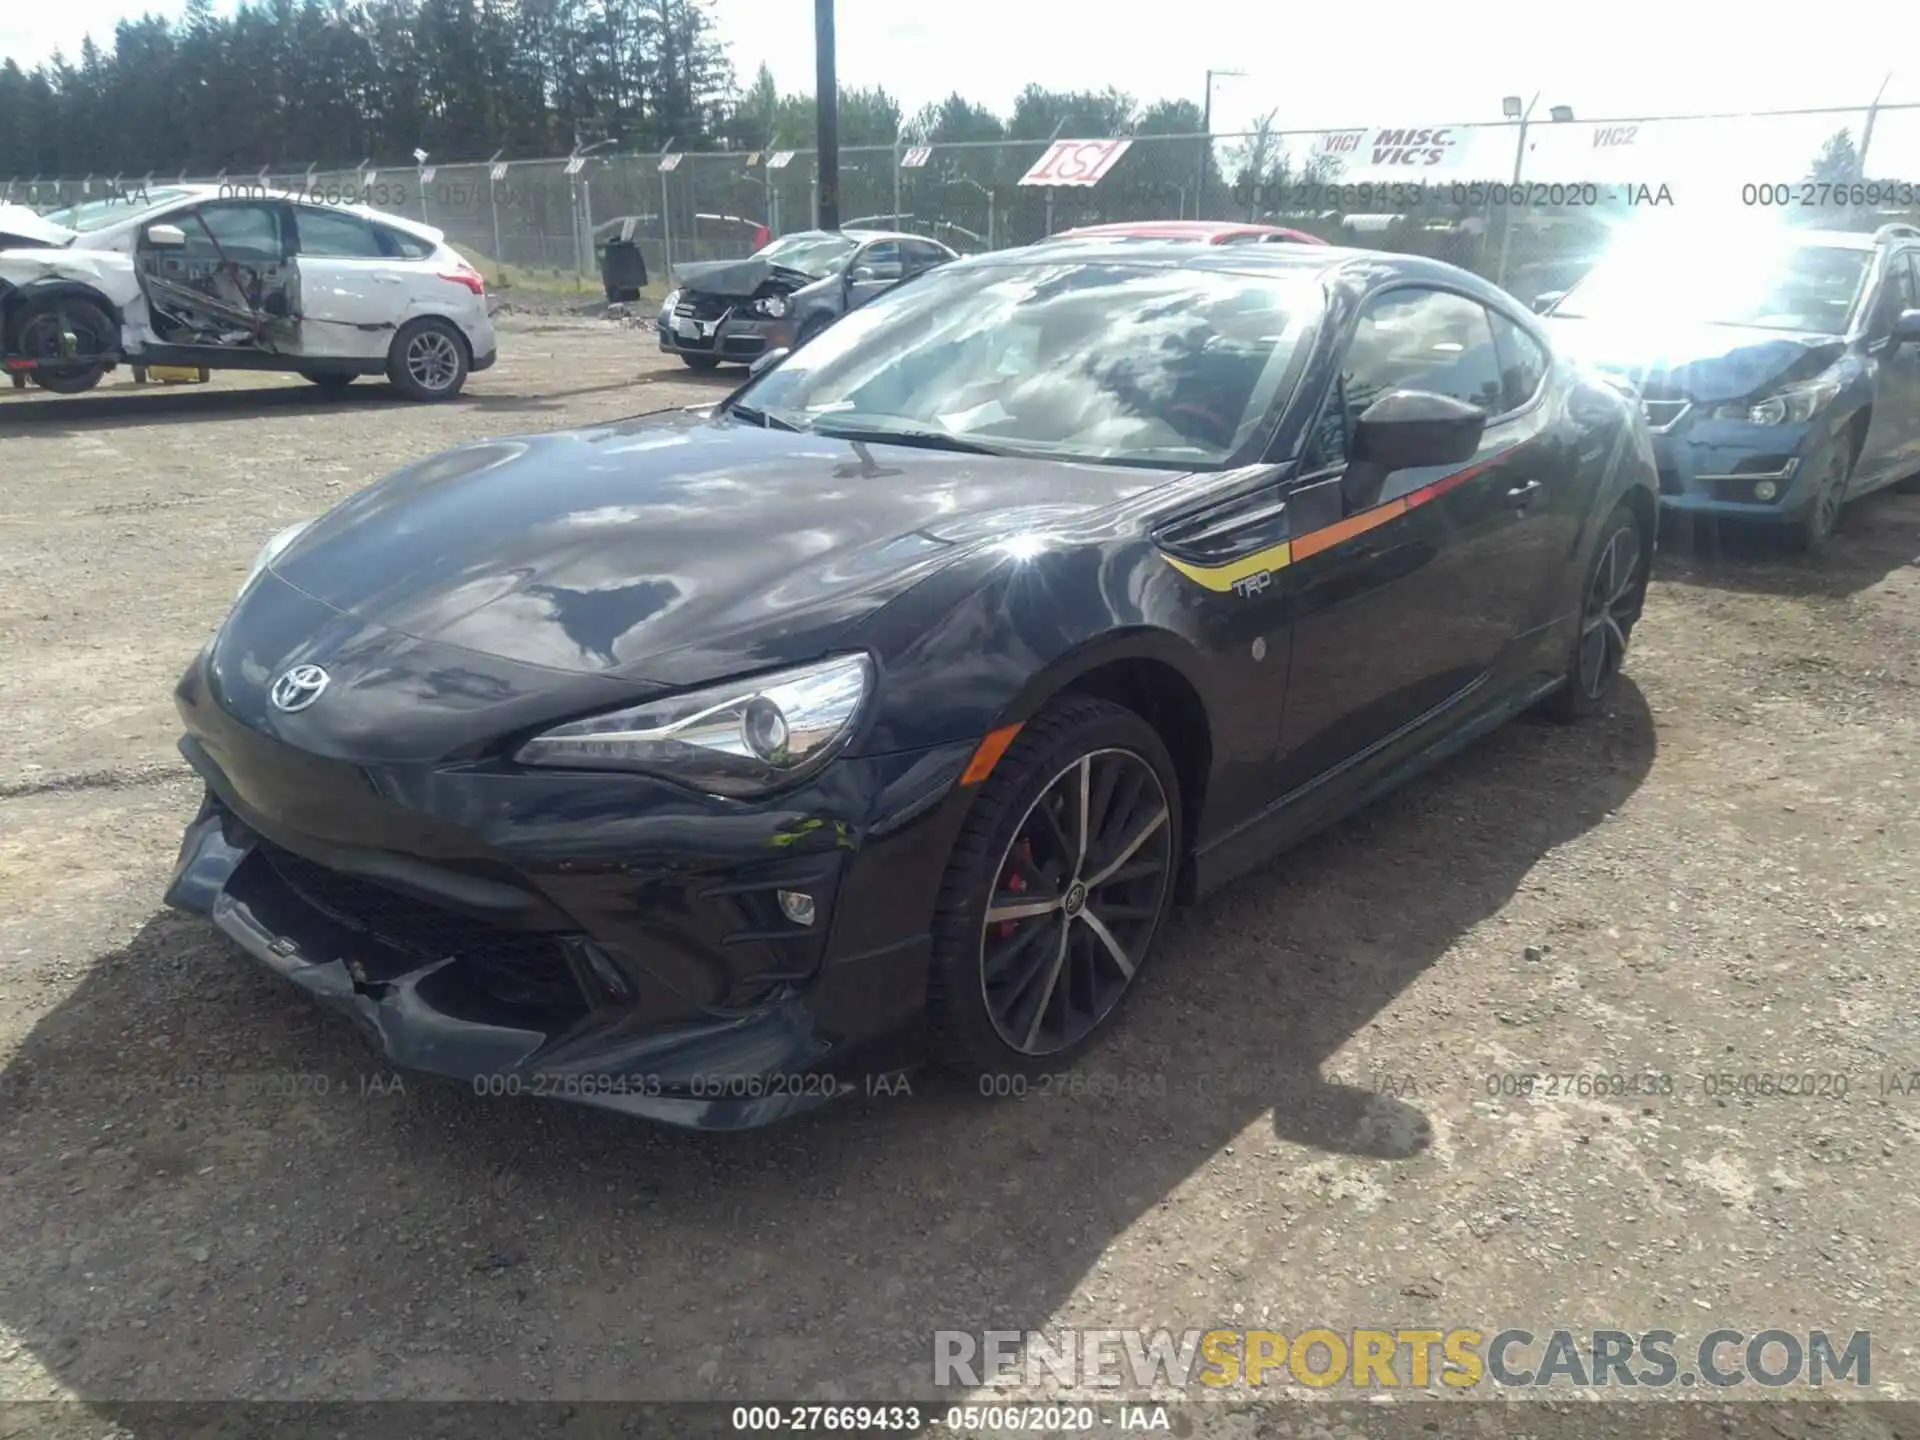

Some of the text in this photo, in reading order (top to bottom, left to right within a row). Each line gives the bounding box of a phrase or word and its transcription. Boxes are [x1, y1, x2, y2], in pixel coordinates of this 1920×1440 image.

[1373, 129, 1456, 146] MISC.
[1593, 127, 1638, 147] VIC2
[1371, 148, 1444, 165] VIC'S
[1232, 571, 1271, 598] TRD
